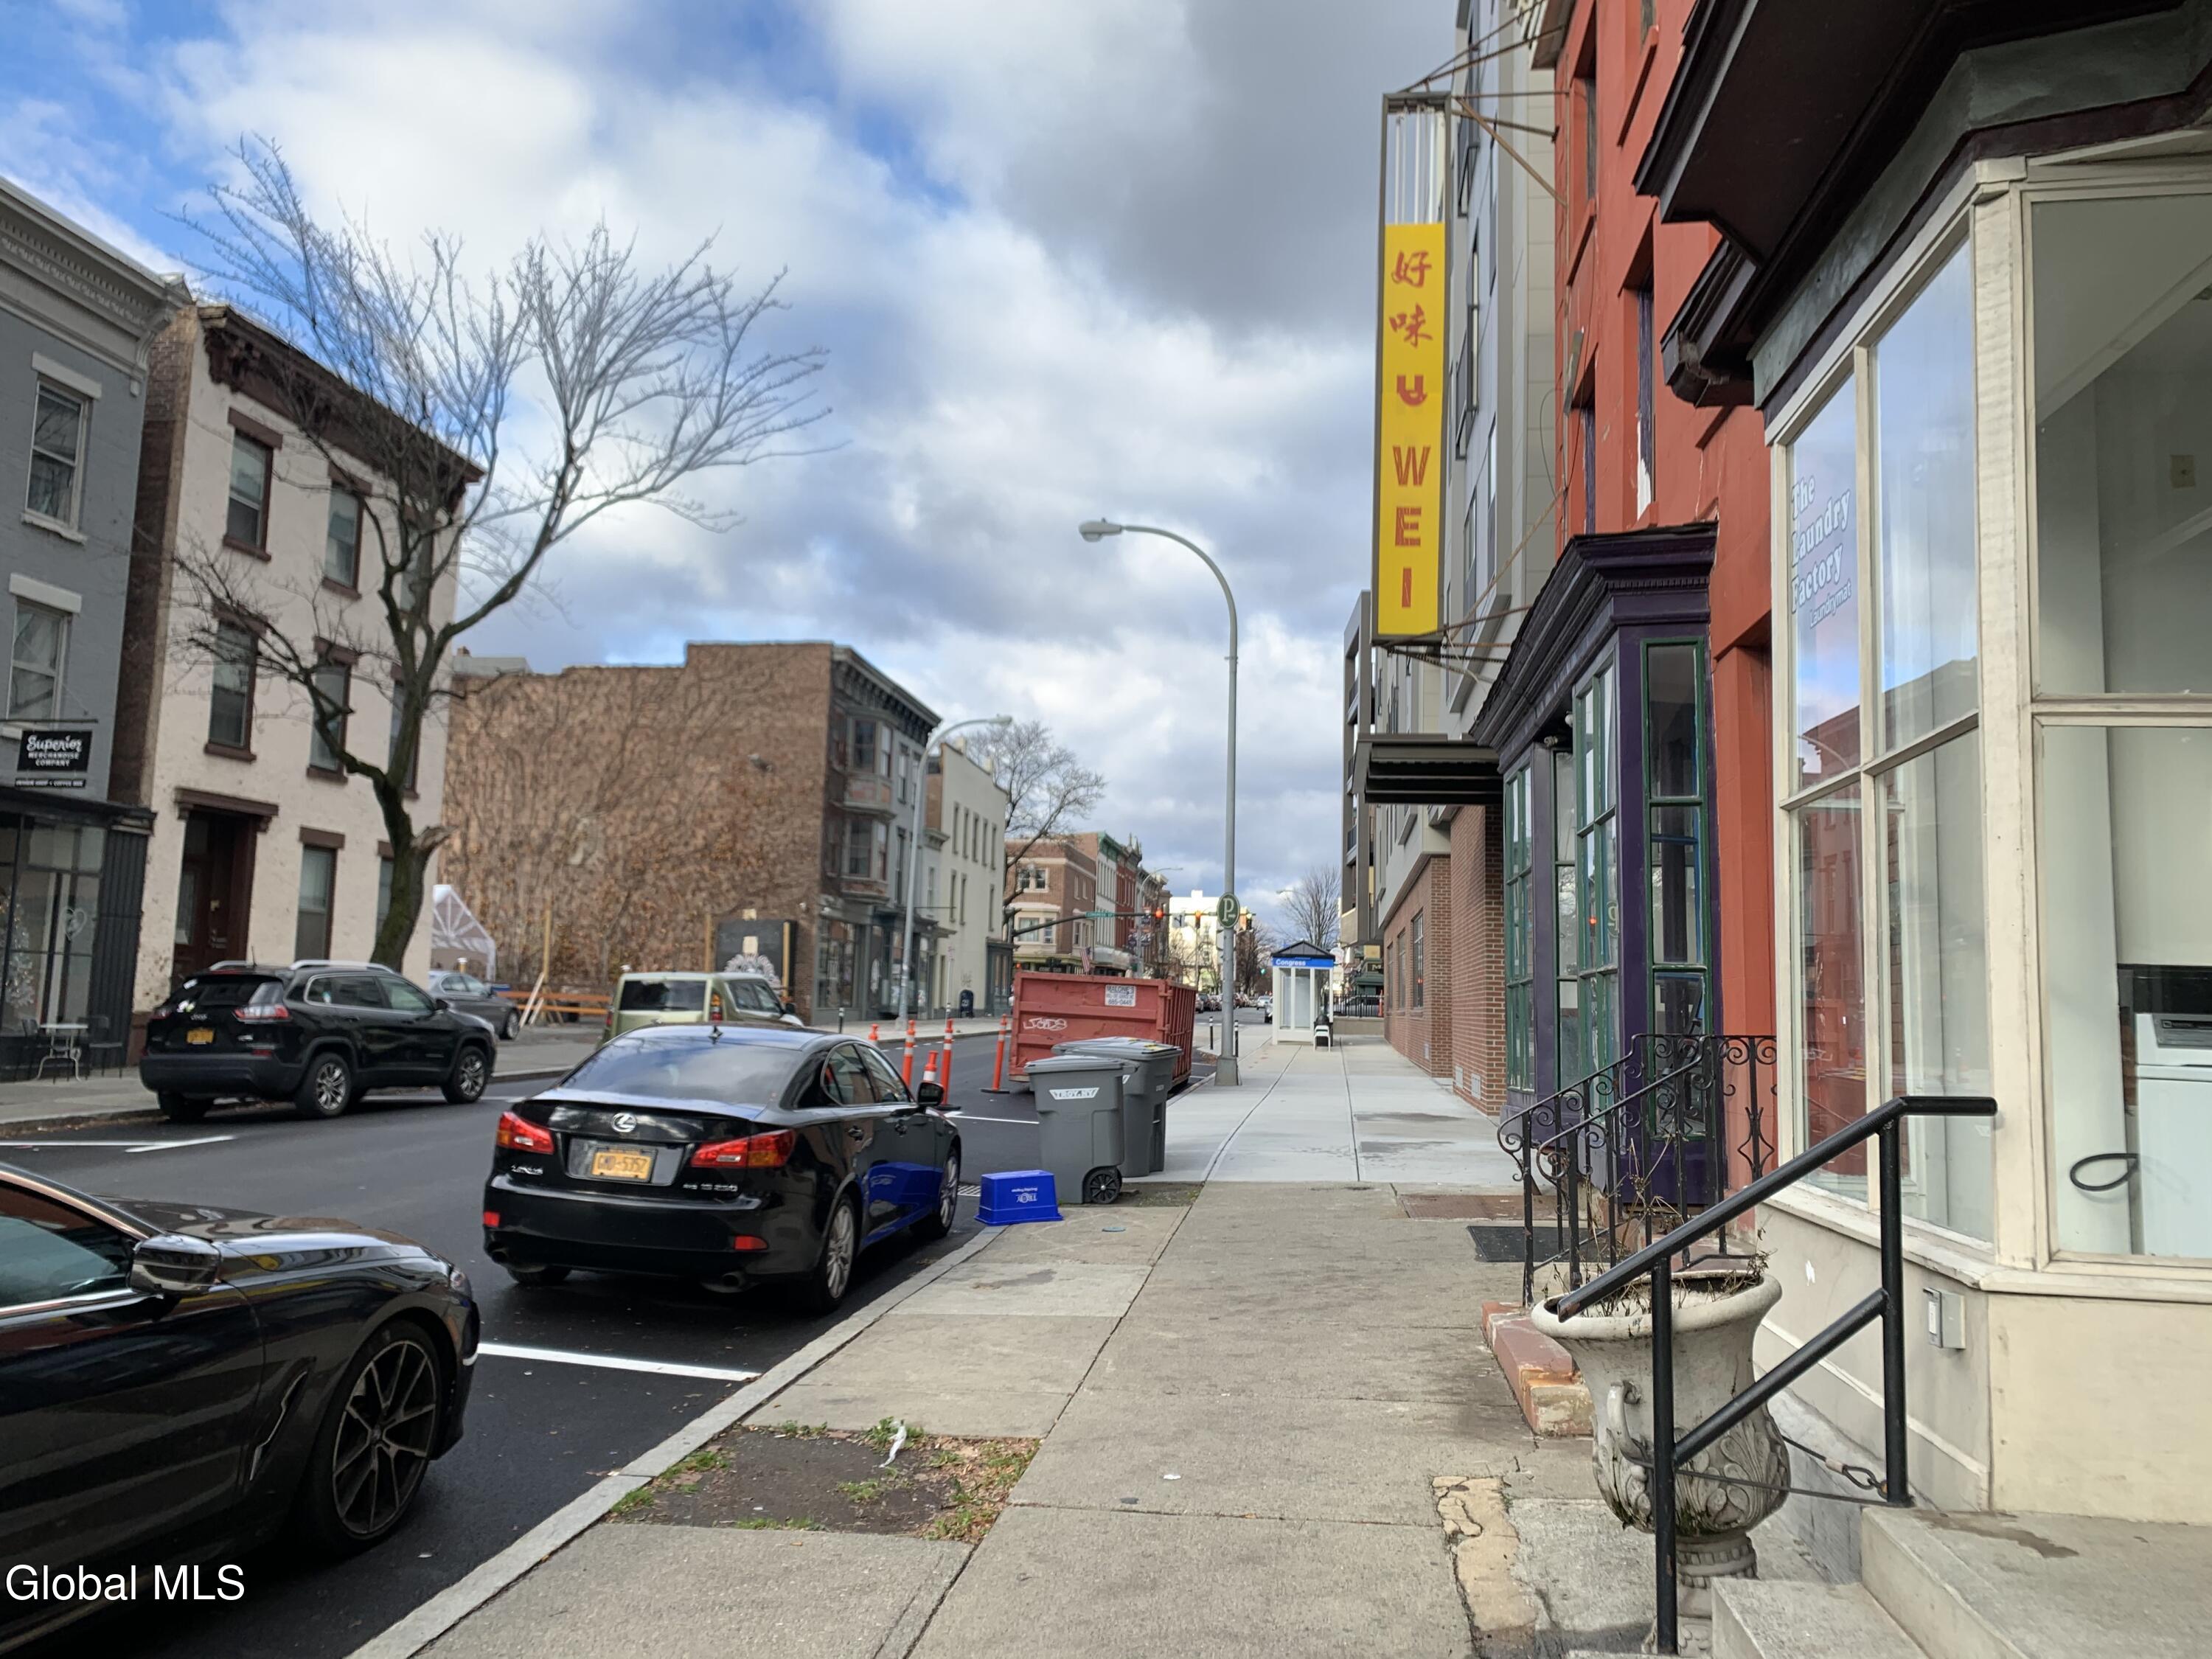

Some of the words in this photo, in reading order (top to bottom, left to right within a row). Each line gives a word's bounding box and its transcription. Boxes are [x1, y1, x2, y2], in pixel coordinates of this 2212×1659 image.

[1792, 475, 1815, 520] The
[1792, 489, 1850, 568] Laundry
[1792, 543, 1843, 614] Factory
[1810, 578, 1851, 628] Laundrymat
[27, 734, 82, 753] Superior
[28, 751, 79, 760] MERCHANDISE
[1222, 897, 1234, 922] P
[1276, 959, 1306, 967] Congress
